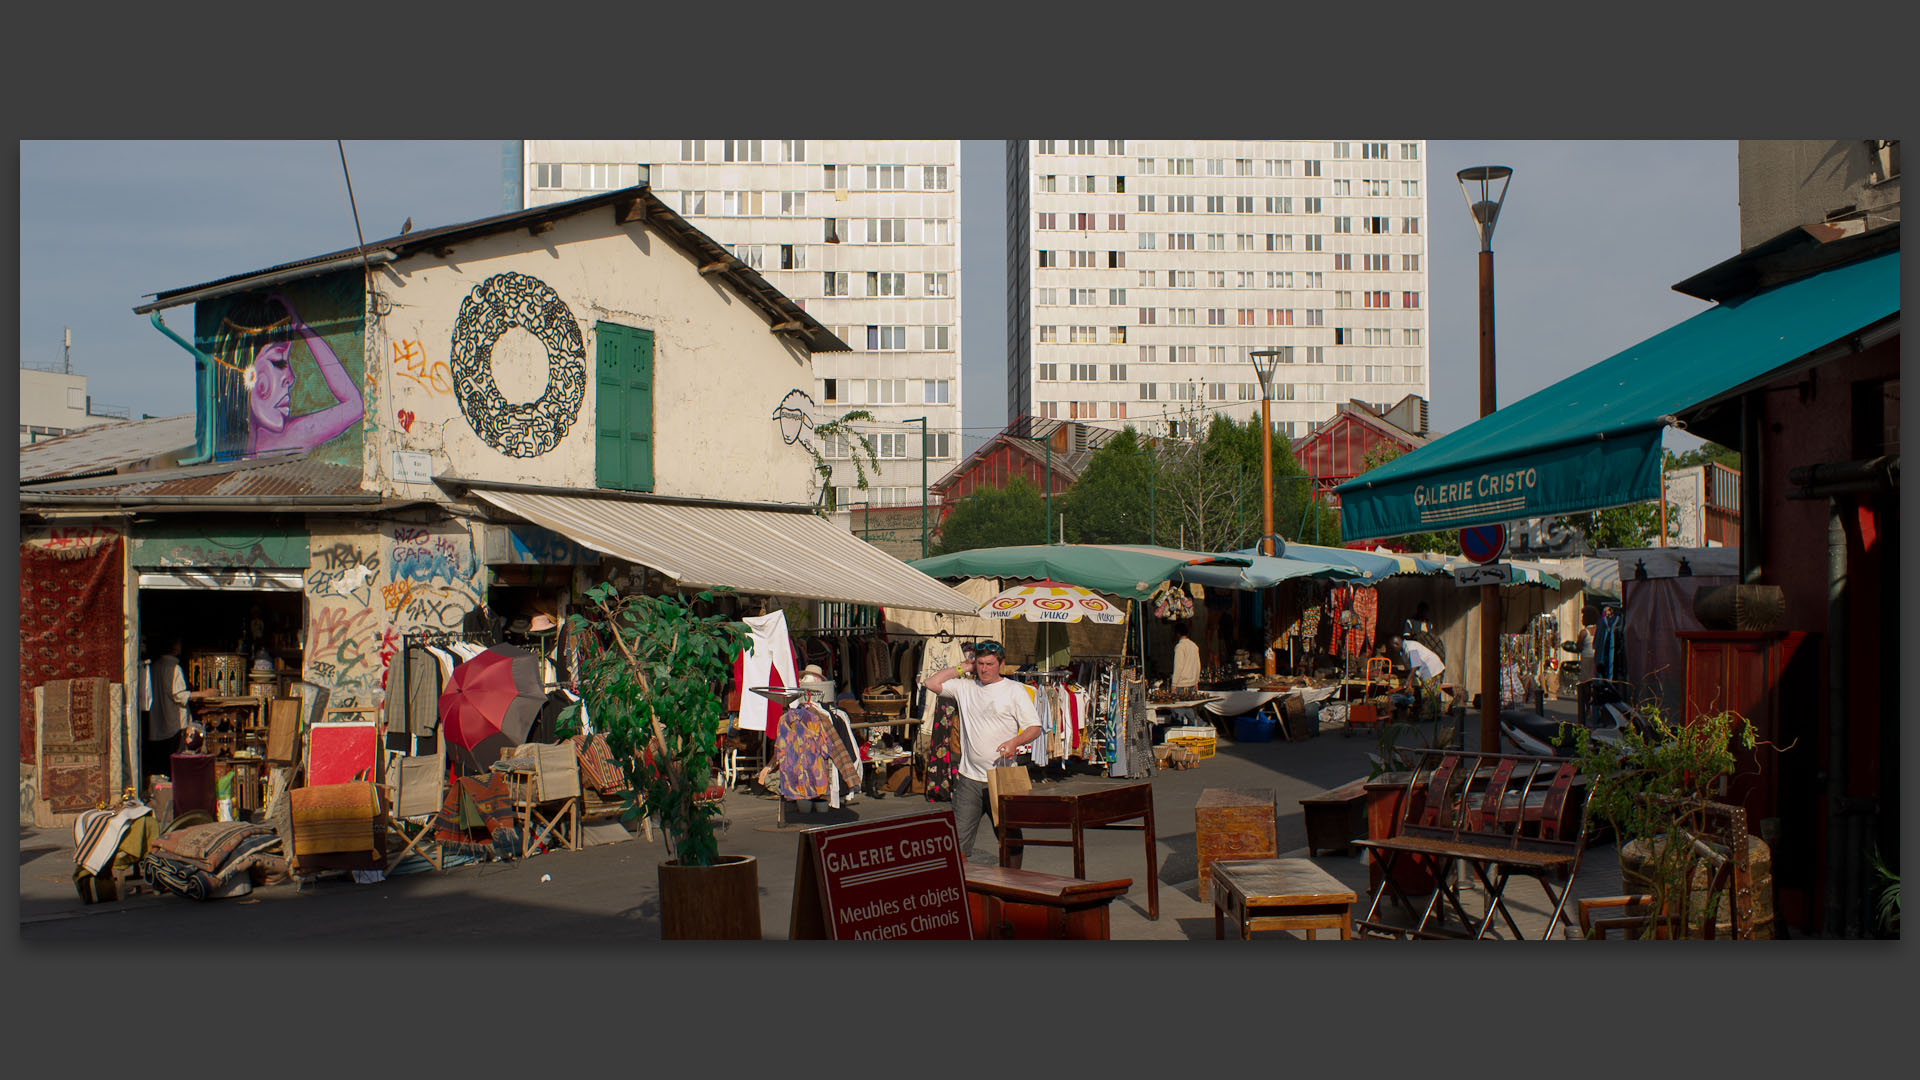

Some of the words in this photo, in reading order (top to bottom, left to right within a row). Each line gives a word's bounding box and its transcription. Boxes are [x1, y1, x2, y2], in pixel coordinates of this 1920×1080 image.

[1414, 480, 1473, 506] GALERIE
[1478, 467, 1537, 497] CRISTO
[827, 845, 896, 873] GALERIE
[899, 835, 953, 859] CRISTO
[839, 899, 900, 925] Meubles
[903, 894, 917, 911] et
[919, 887, 960, 908] objets
[854, 922, 908, 941] Anciens
[910, 910, 960, 933] Chinois
